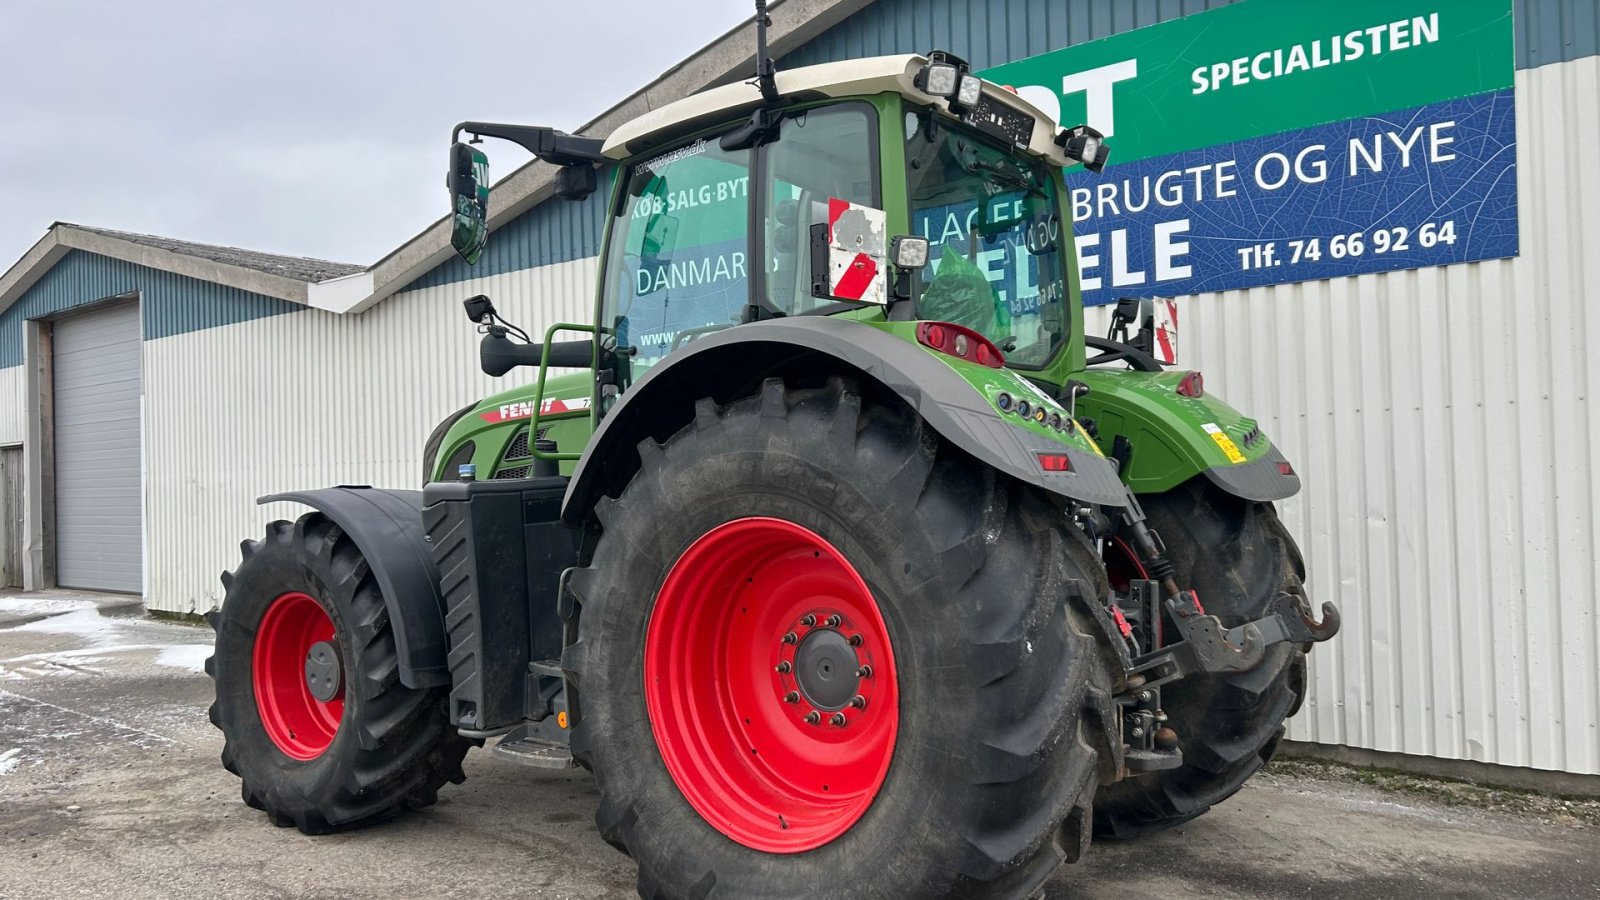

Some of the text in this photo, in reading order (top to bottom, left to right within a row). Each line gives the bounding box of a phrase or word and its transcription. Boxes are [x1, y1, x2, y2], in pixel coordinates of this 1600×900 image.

[1191, 12, 1440, 95] SPECIALISTEN
[1072, 159, 1236, 222] BRUGTE
[1254, 144, 1327, 191] OG
[1349, 120, 1456, 177] NYE
[637, 252, 777, 296] DANMAR
[1238, 220, 1457, 271] Tlf. 74 66 92 64
